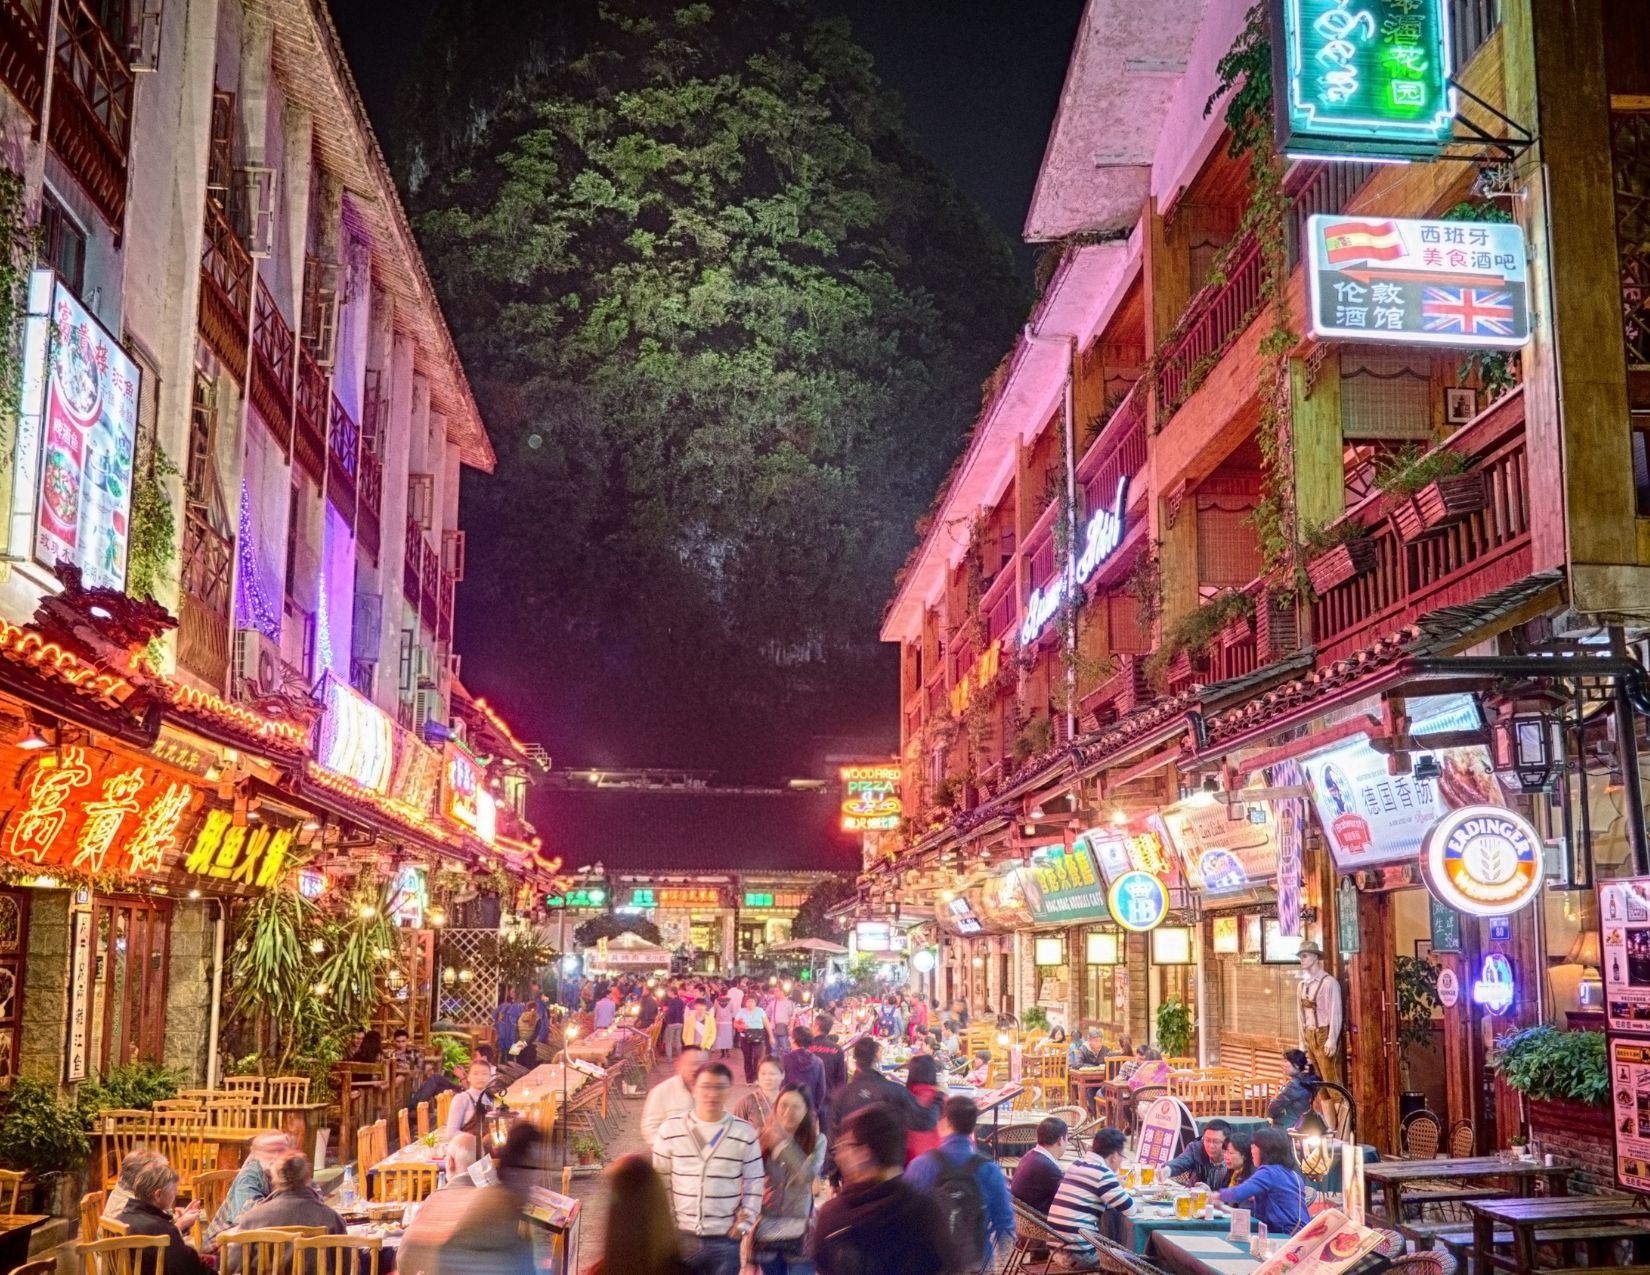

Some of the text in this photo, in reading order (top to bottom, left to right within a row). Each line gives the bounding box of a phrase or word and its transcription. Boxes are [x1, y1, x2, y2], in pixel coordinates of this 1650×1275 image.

[1421, 224, 1490, 246] 西班牙
[1422, 247, 1517, 271] 美食酒吧
[1333, 281, 1405, 304] 伦敦
[1335, 305, 1405, 330] 酒馆
[848, 781, 895, 795] PIZZA
[1361, 776, 1434, 818] 德国香肠
[1447, 818, 1531, 857] ERDINGER
